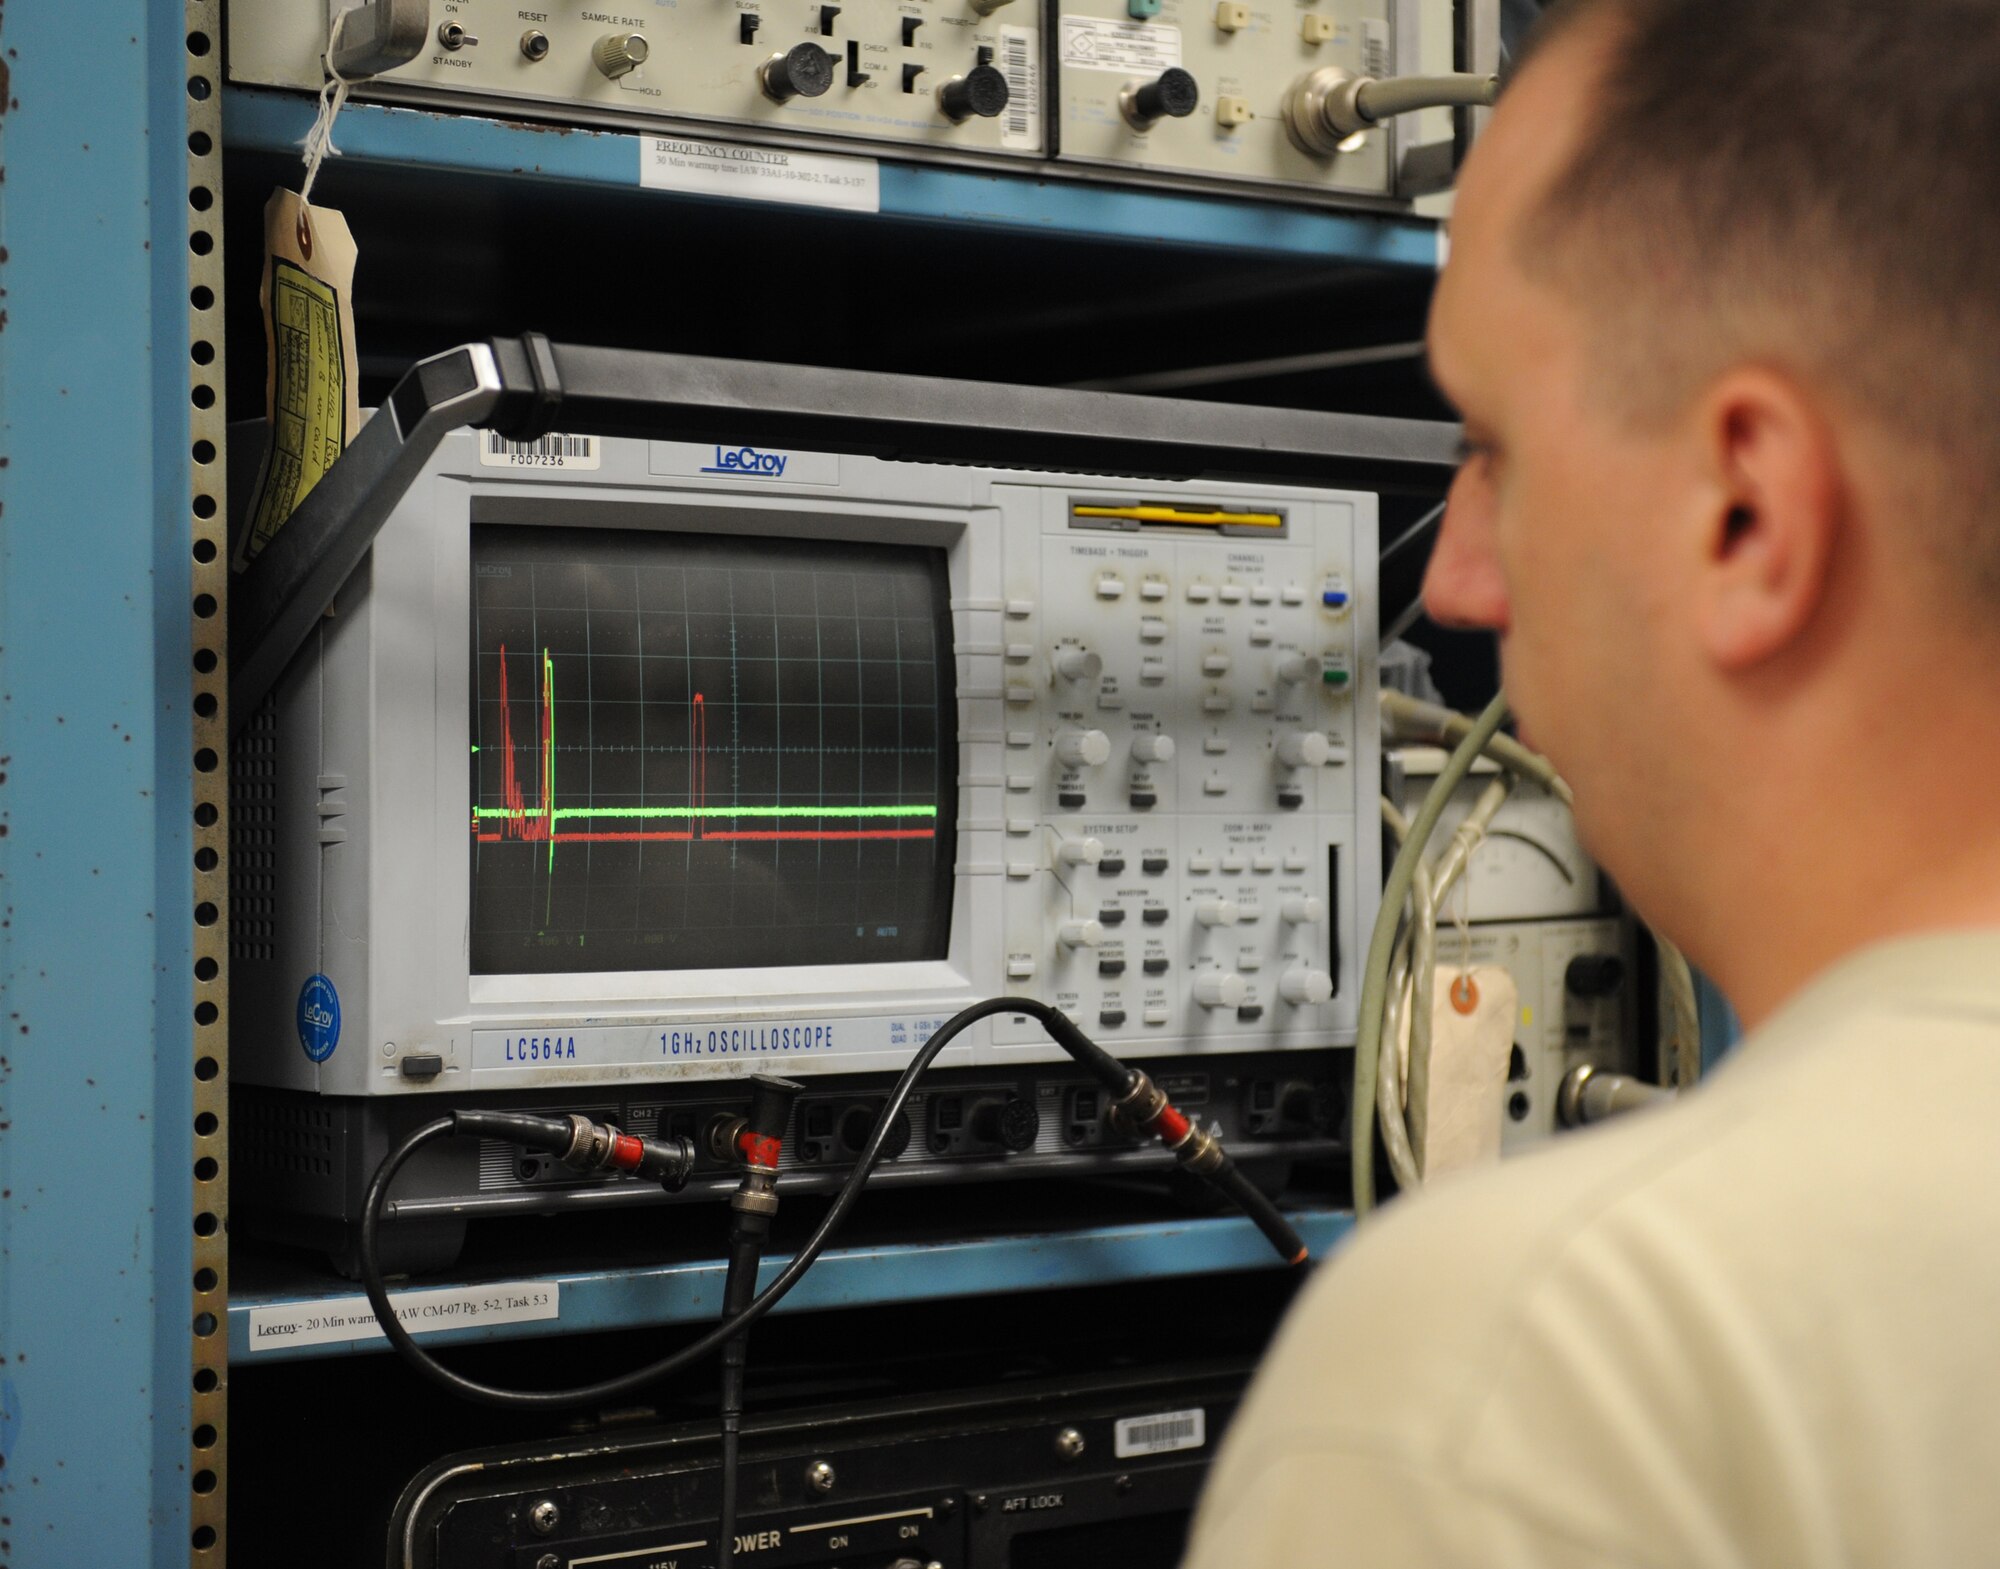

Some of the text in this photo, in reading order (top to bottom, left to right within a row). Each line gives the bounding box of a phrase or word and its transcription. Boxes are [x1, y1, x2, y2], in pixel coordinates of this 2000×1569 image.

[445, 4, 458, 13] ON
[518, 11, 548, 22] RESET
[581, 11, 646, 28] SAMPLE RATE
[432, 56, 473, 68] STANDBY
[639, 86, 662, 97] HOLD
[656, 139, 789, 166] FREQUENCY COUNTER
[668, 156, 686, 168] Min
[510, 454, 564, 467] F007236
[716, 446, 787, 476] LeCroy
[305, 1000, 334, 1027] LeCroy
[660, 1025, 833, 1055] 1GHz OSCILLOSCOPE
[506, 1036, 576, 1061] LC564A
[633, 1109, 646, 1119] CH
[258, 1320, 303, 1337] Lecroy-
[306, 1318, 320, 1331] 20
[322, 1315, 345, 1329] Min
[348, 1314, 379, 1326] warm
[423, 1302, 460, 1317] CM-07
[463, 1302, 480, 1319] Pg.
[483, 1298, 503, 1313] 5-2,
[505, 1296, 530, 1309] Task
[533, 1293, 549, 1306] 5.3
[1003, 1494, 1064, 1512] AFT LOCK
[900, 1526, 919, 1539] ON
[733, 1530, 781, 1554] OWER
[829, 1536, 848, 1549] ON
